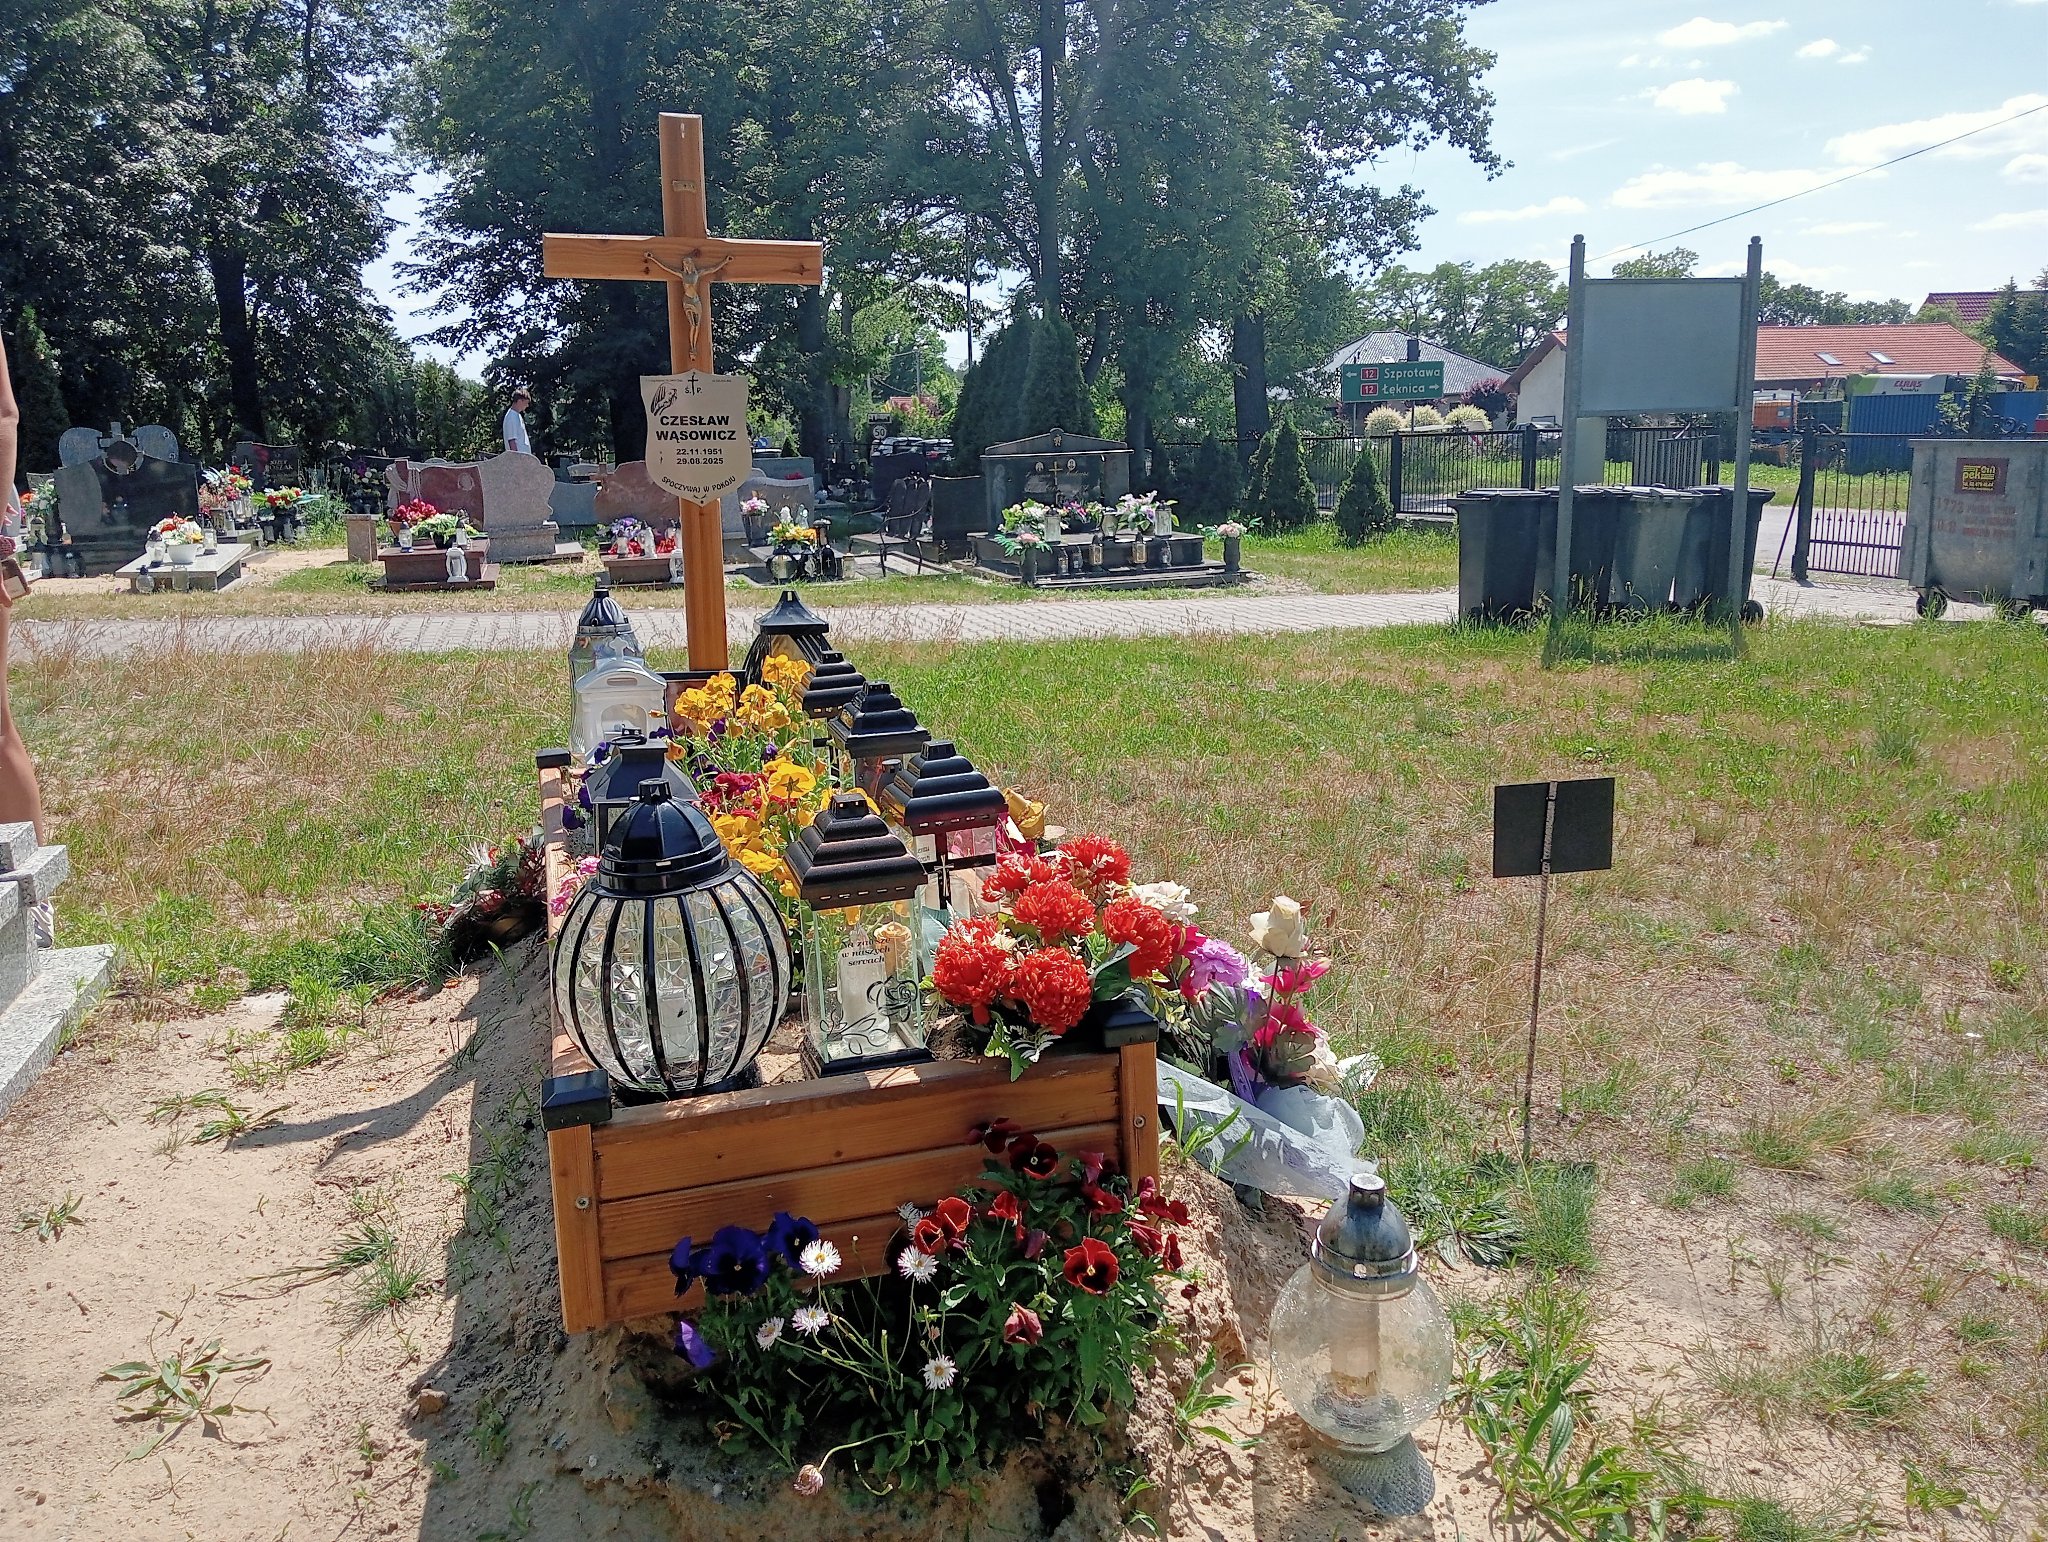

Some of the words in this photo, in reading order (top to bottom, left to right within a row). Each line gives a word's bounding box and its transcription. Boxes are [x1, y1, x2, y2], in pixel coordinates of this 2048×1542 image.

[1364, 370, 1374, 378] 12
[1383, 368, 1441, 381] Szprotawa
[1364, 386, 1374, 394] 12
[1382, 384, 1425, 396] Łęknica
[1893, 380, 1923, 388] CLAAS
[660, 415, 730, 426] CZESŁAW
[656, 430, 737, 443] WĄSOWICZ
[874, 428, 885, 437] 50
[661, 476, 701, 493] SPOCZYWAJ
[703, 485, 711, 493] W
[712, 475, 736, 491] POKOJU
[852, 945, 890, 957] naszych
[848, 955, 885, 966] sercach
